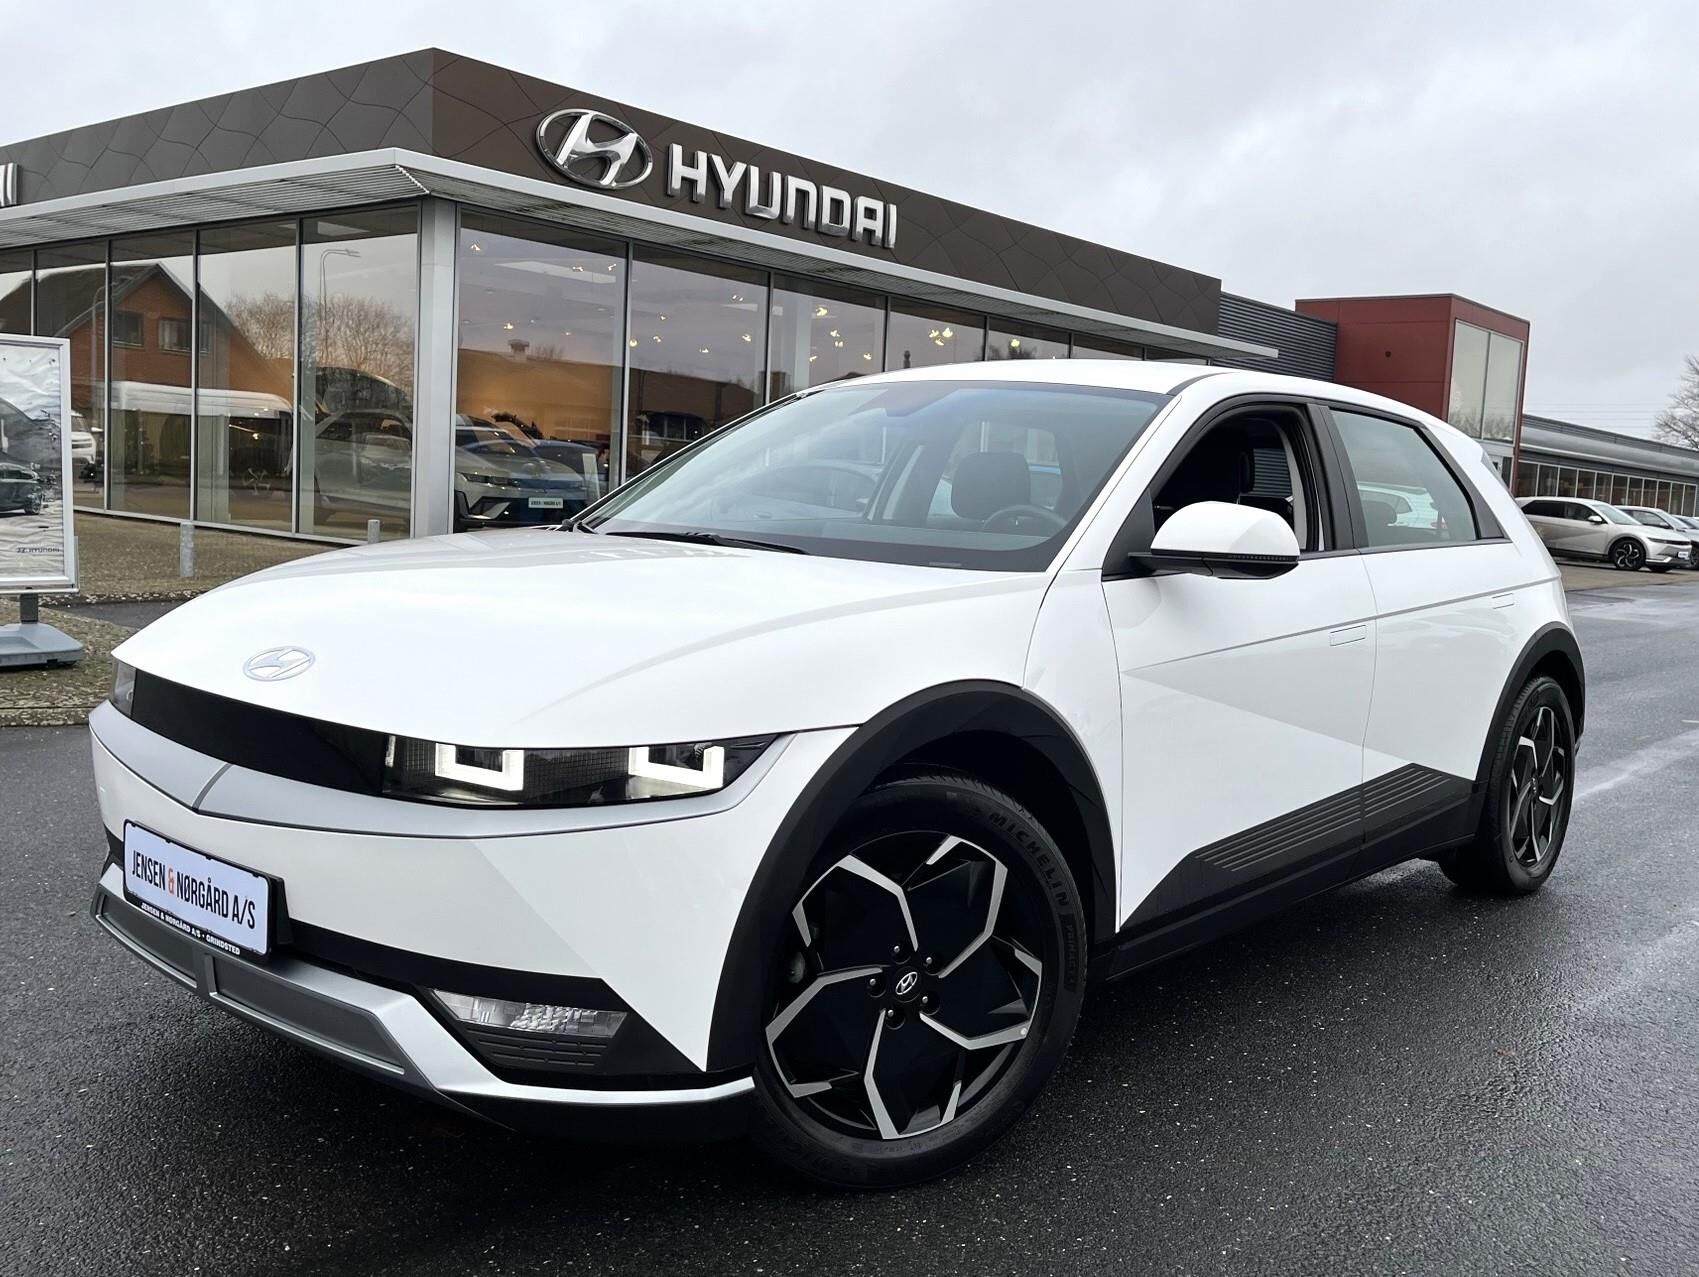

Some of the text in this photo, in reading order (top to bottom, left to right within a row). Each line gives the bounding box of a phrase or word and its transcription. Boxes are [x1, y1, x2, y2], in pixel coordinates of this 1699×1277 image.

[667, 143, 898, 248] HYUNDAI
[132, 850, 256, 929] JENSEN & NØRGÅRD A/S
[989, 811, 1070, 907] MICHELIN
[141, 902, 160, 918] JENSEN
[206, 934, 241, 956] GRINDSTED
